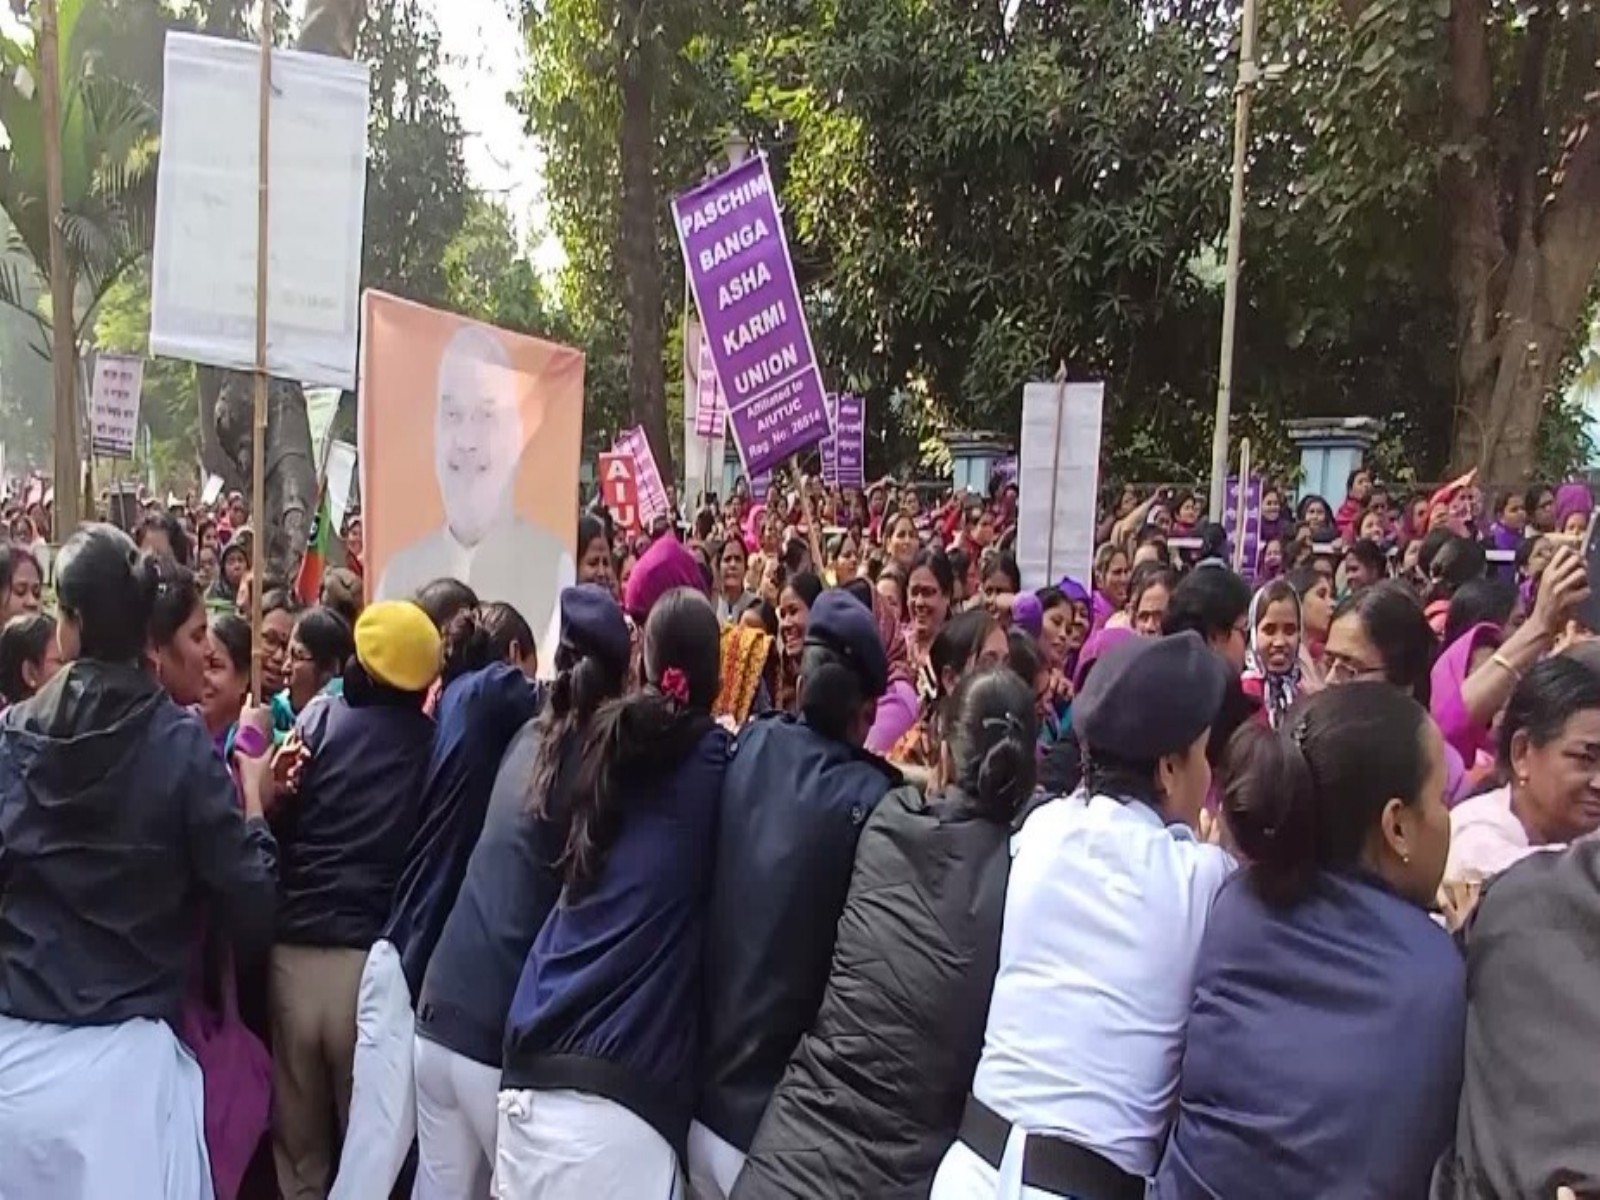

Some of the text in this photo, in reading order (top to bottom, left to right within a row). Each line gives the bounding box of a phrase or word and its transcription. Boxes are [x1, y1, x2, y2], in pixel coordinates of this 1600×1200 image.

[680, 173, 769, 237] PASCHIM
[698, 218, 769, 272] BANGA
[717, 261, 772, 310] ASHA
[722, 300, 786, 356] KARMI
[733, 343, 798, 394] UNION
[747, 379, 804, 419] Affiliated to
[757, 398, 803, 433] AIUTUC
[790, 409, 822, 435] 26514
